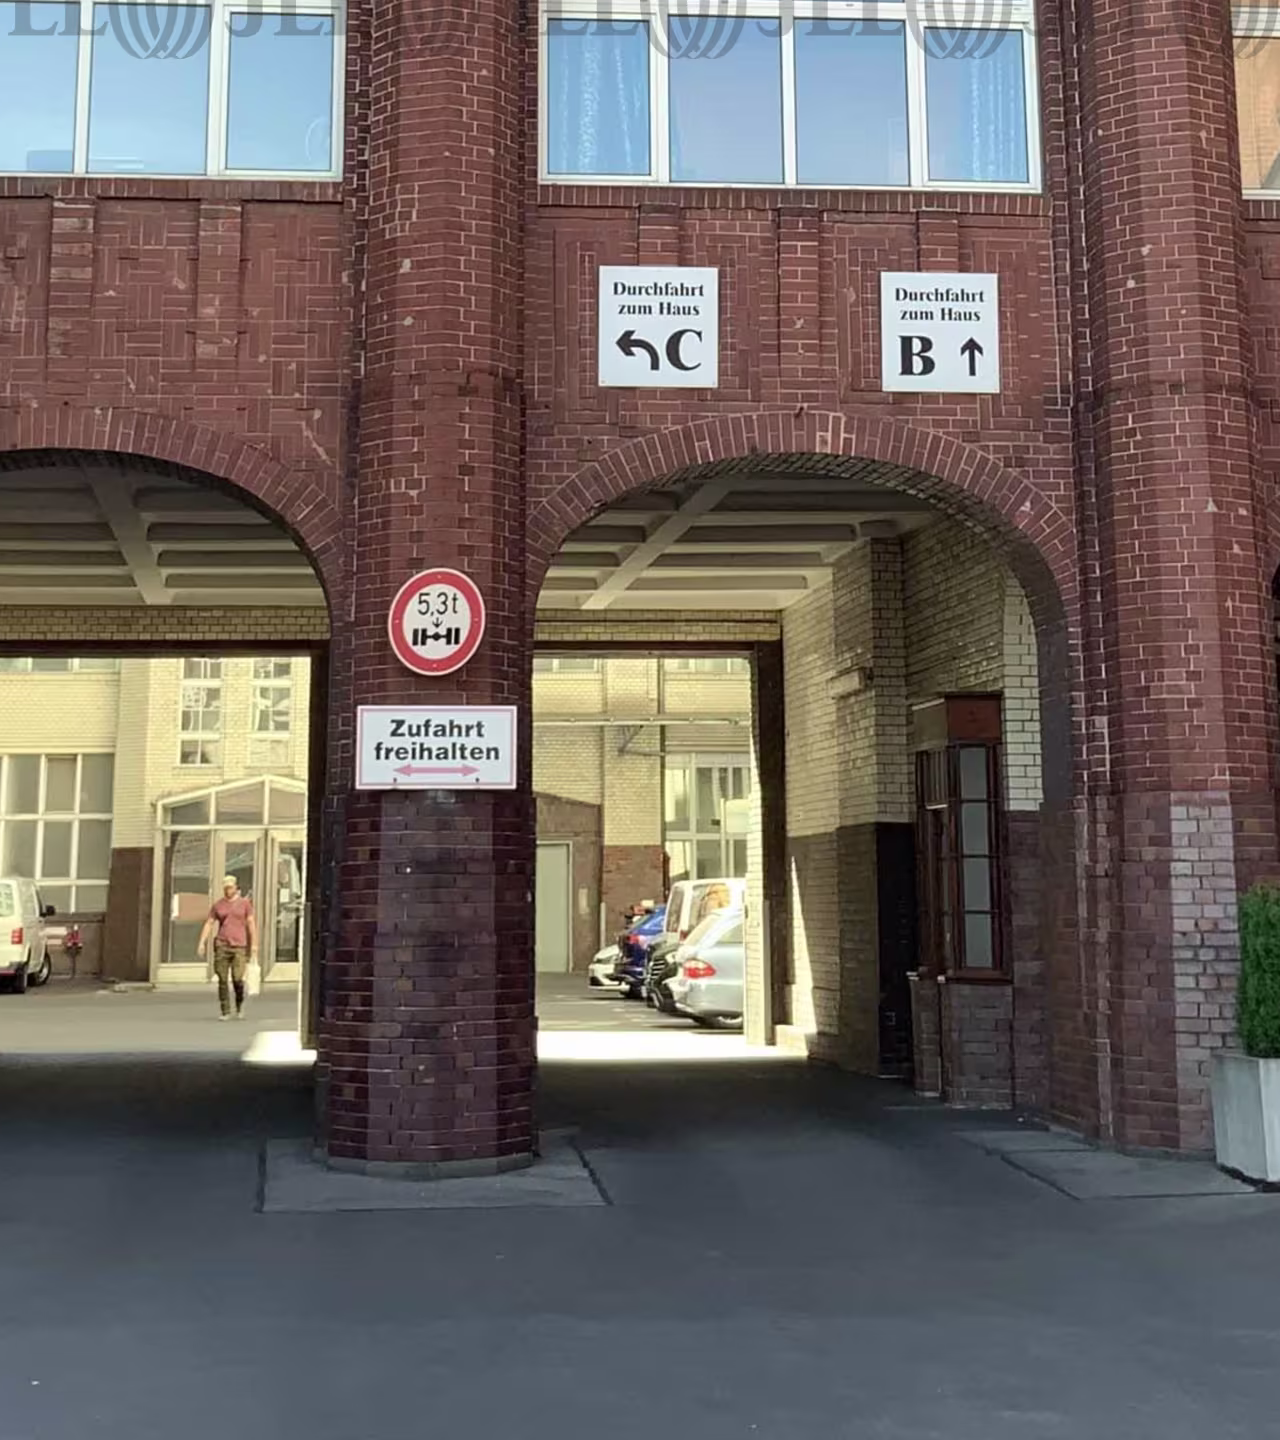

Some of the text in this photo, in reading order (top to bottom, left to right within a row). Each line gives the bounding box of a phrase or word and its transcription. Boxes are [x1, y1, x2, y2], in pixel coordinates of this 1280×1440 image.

[613, 281, 704, 297] Durchfahrt
[895, 287, 984, 303] Durchfahrt
[618, 301, 700, 316] zum Haus
[900, 307, 980, 322] zum Haus
[665, 328, 702, 371] C
[898, 335, 935, 376] B
[389, 719, 484, 738] Zufahrt
[374, 742, 500, 761] freihalten
